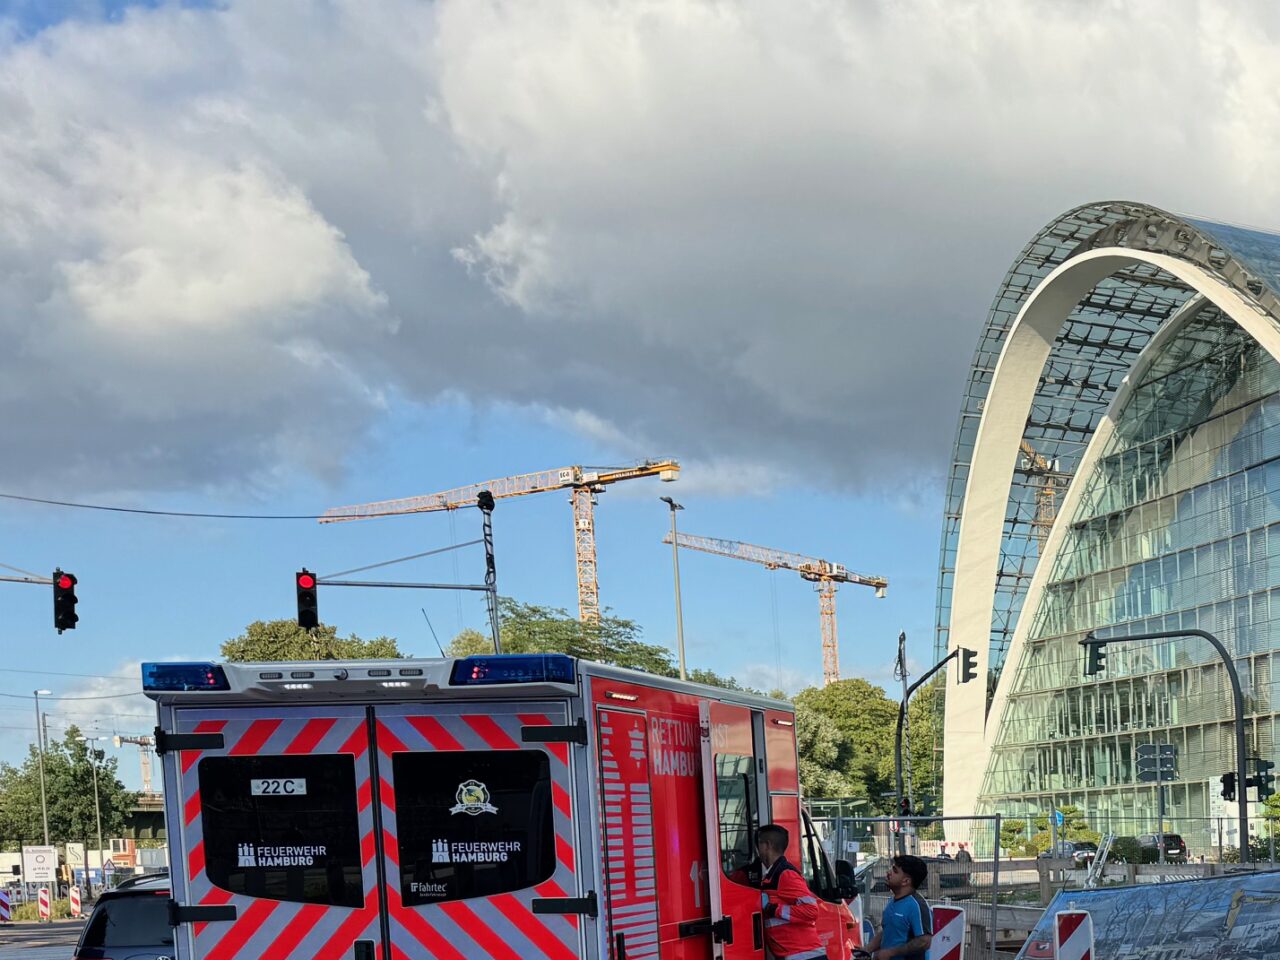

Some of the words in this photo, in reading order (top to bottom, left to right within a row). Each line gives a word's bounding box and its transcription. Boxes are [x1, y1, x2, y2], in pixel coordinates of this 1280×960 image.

[257, 846, 327, 857] FEUERWEHR
[451, 842, 521, 852] FEUERWEHR
[258, 856, 314, 867] HAMBURG
[452, 852, 508, 862] HAMBURG
[418, 882, 448, 892] fahrtec
